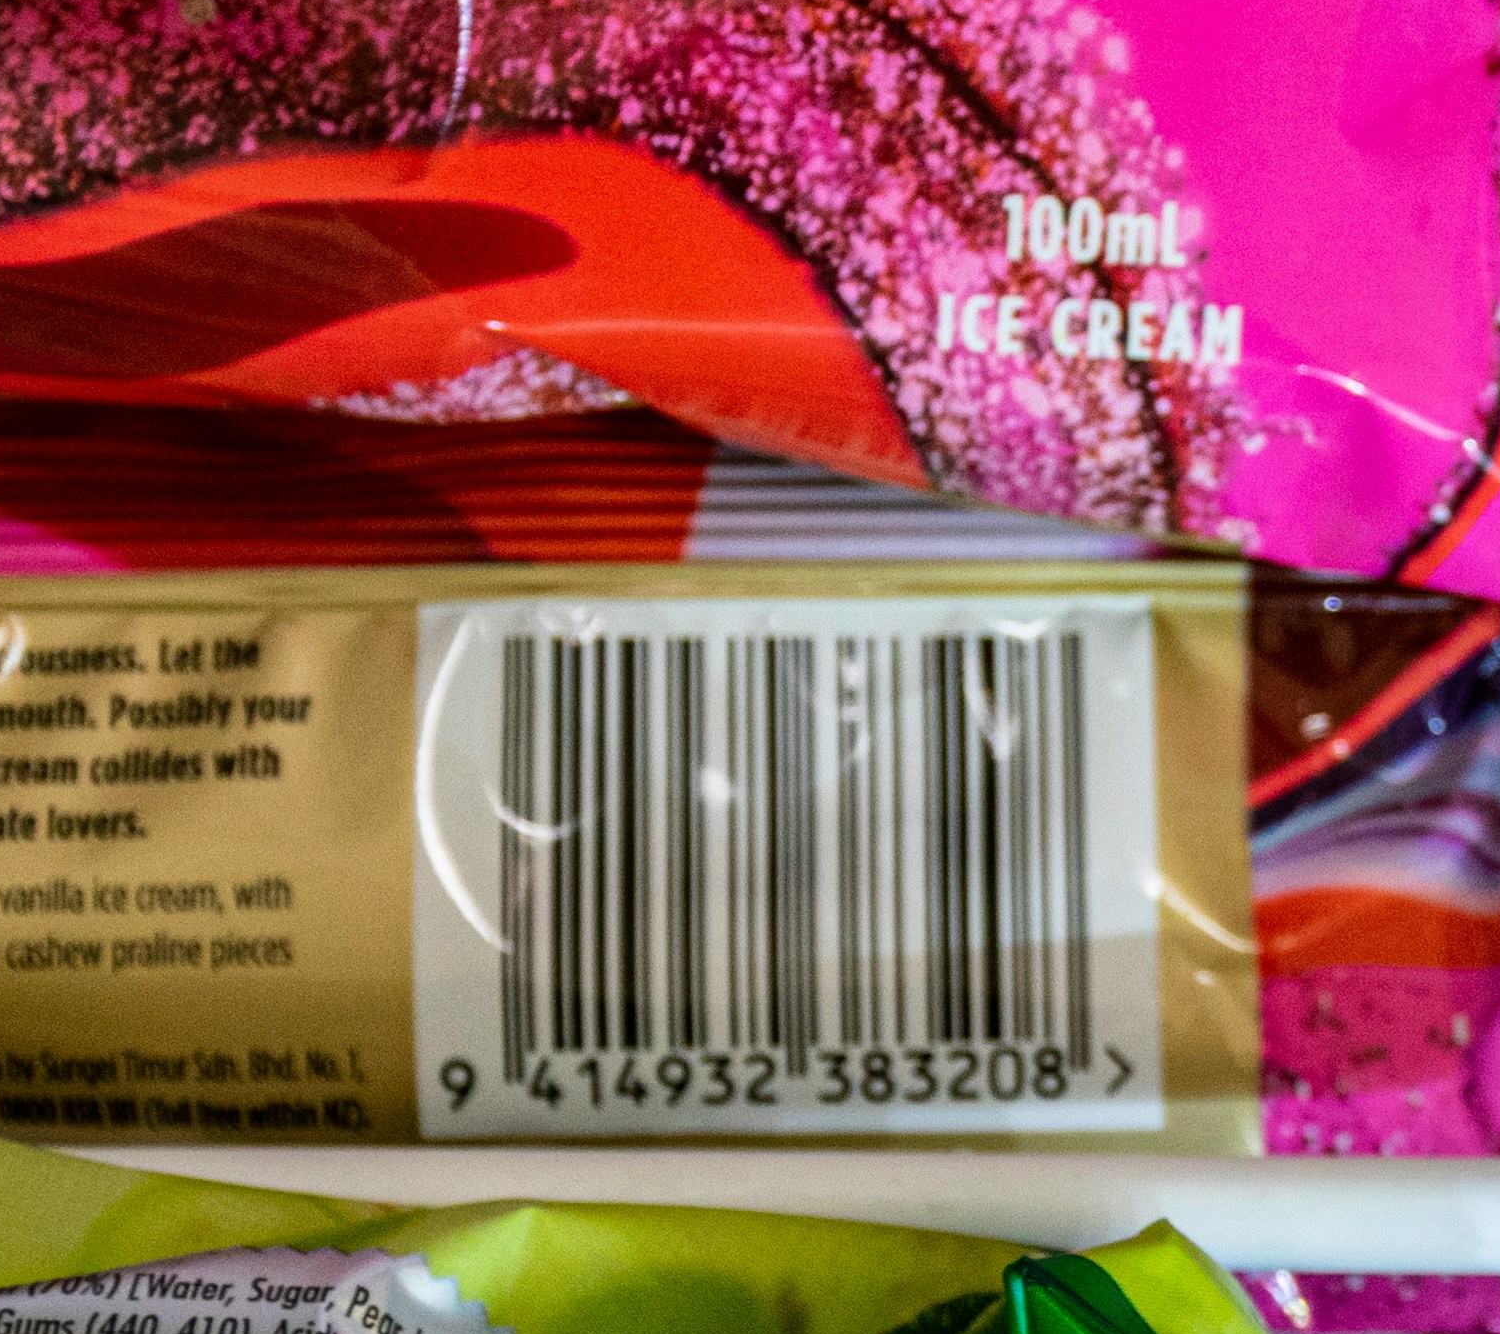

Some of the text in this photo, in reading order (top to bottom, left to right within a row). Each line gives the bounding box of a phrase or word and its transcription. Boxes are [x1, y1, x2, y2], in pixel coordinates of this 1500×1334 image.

[1002, 193, 1188, 267] 100mL
[937, 293, 1244, 365] ICE CREAM
[108, 692, 233, 730] Possibly
[242, 693, 311, 726] your
[90, 748, 206, 784] collides
[214, 746, 282, 779] with
[47, 806, 148, 839] lovers.
[440, 1047, 1070, 1110] 9 414932 383208
